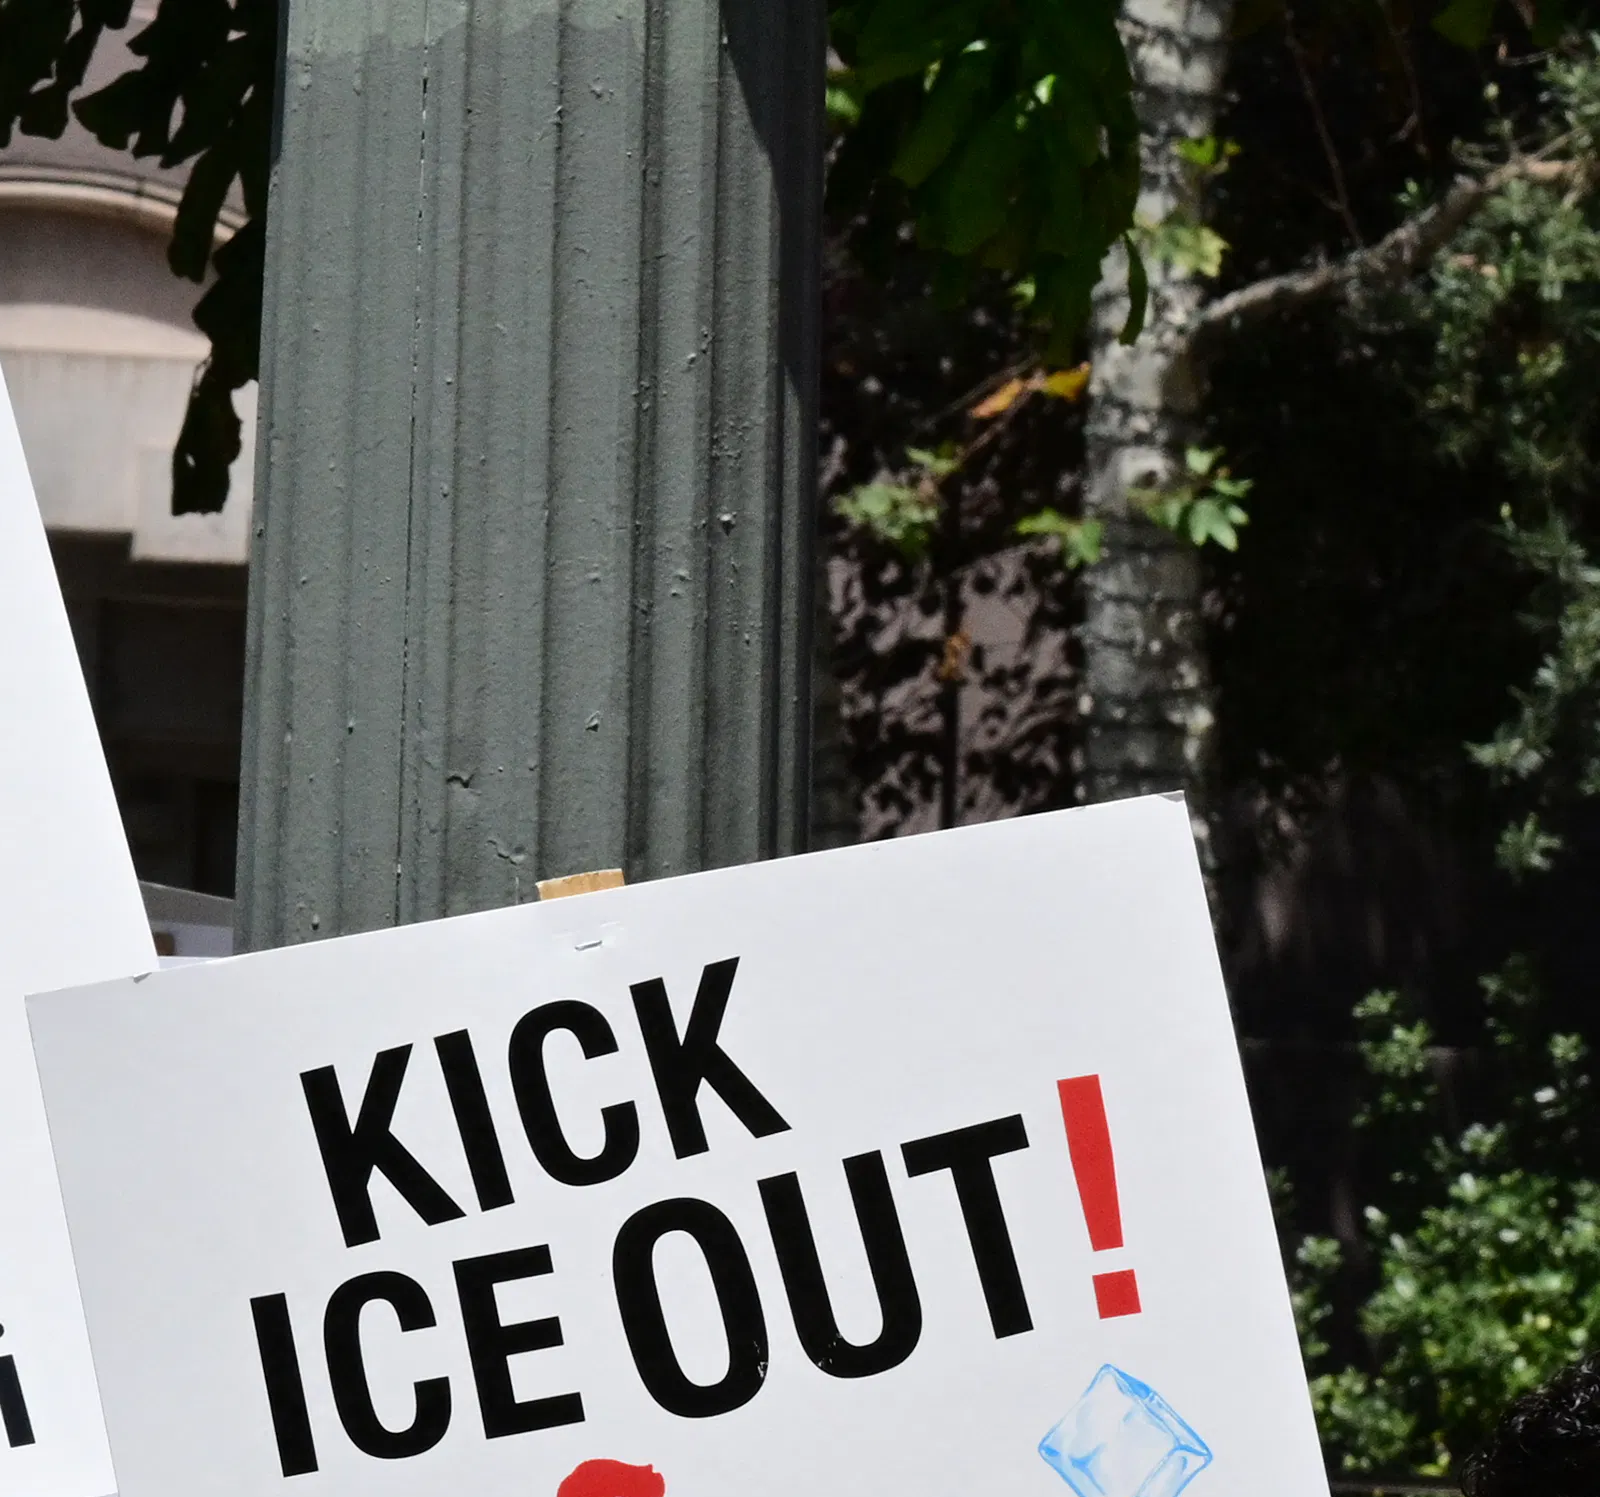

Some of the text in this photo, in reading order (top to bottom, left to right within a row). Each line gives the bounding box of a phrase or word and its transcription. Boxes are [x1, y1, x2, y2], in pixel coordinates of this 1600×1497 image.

[300, 957, 791, 1247] KICK
[250, 1074, 1142, 1477] ICE OUT!
